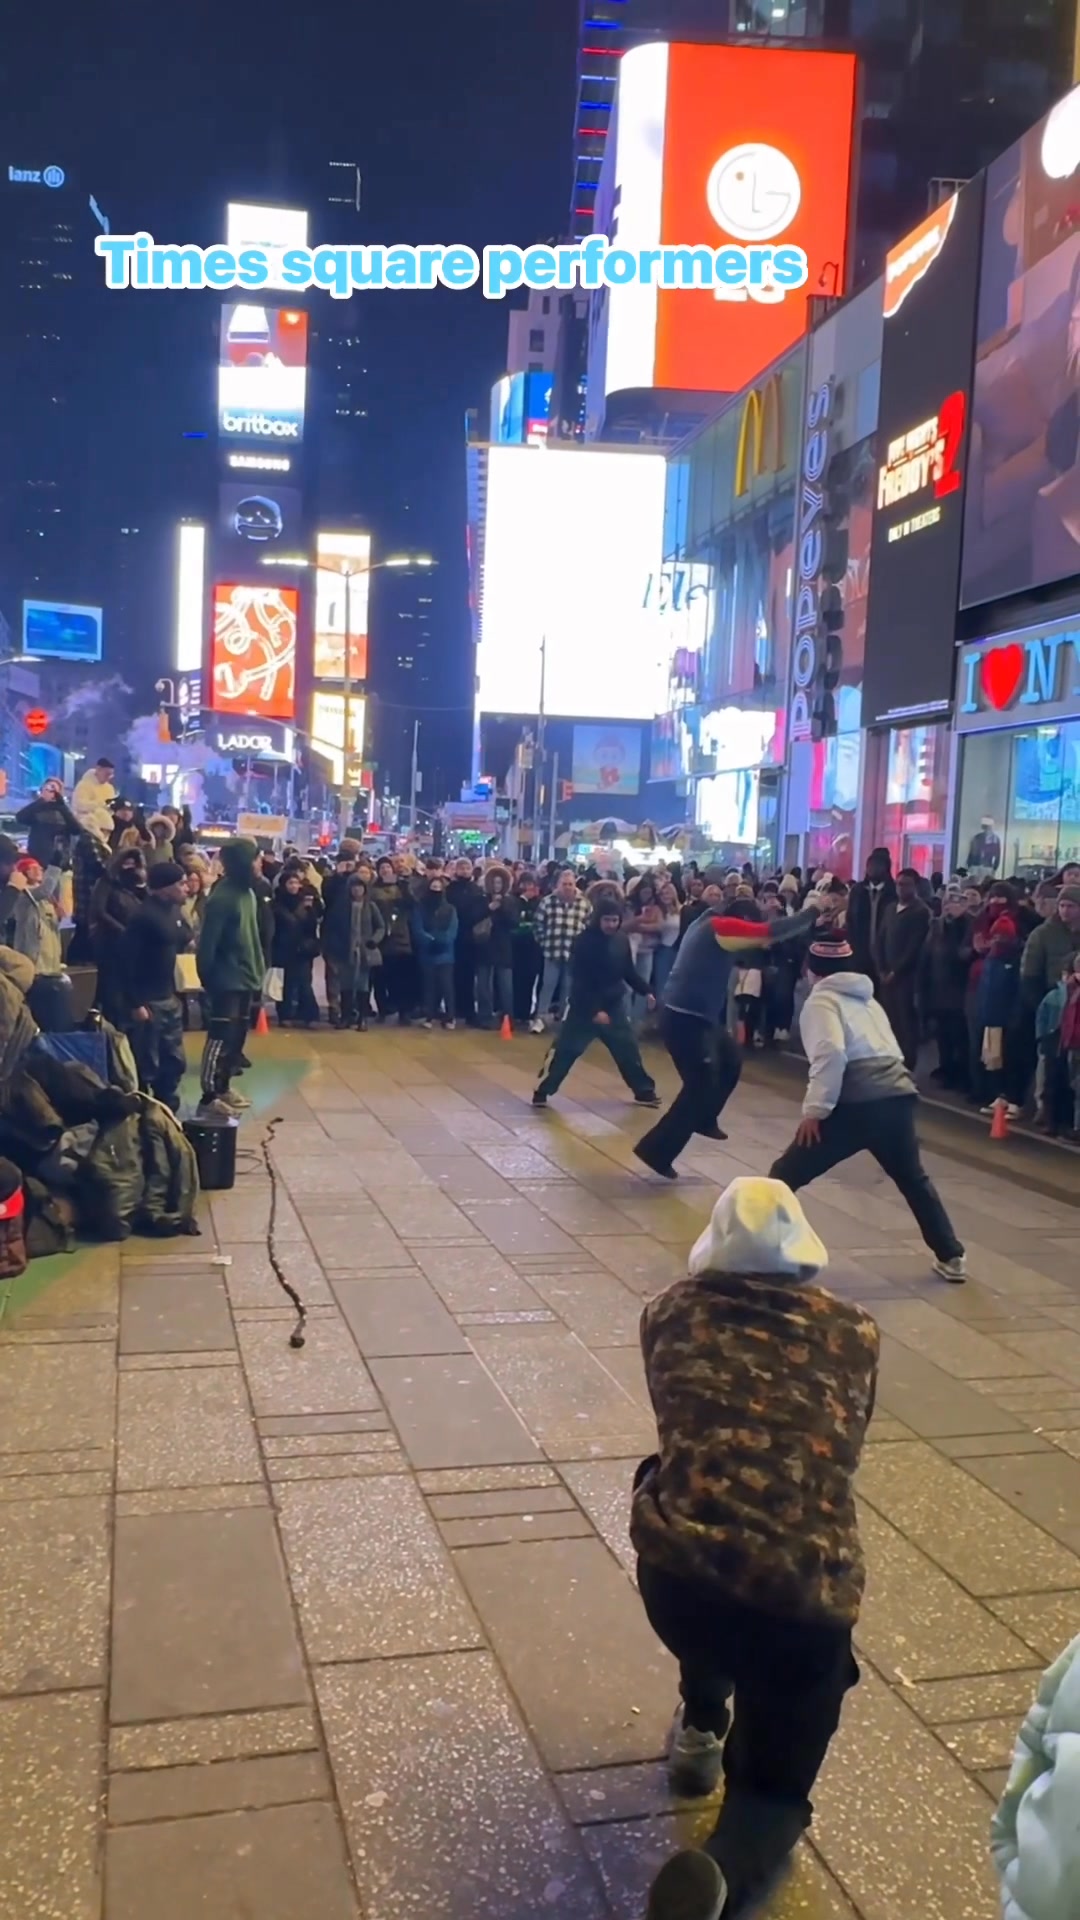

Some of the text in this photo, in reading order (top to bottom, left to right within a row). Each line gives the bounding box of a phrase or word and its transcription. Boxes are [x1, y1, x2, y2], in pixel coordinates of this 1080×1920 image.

[223, 410, 298, 437] britbox
[934, 391, 966, 498] 2
[961, 652, 981, 714] I
